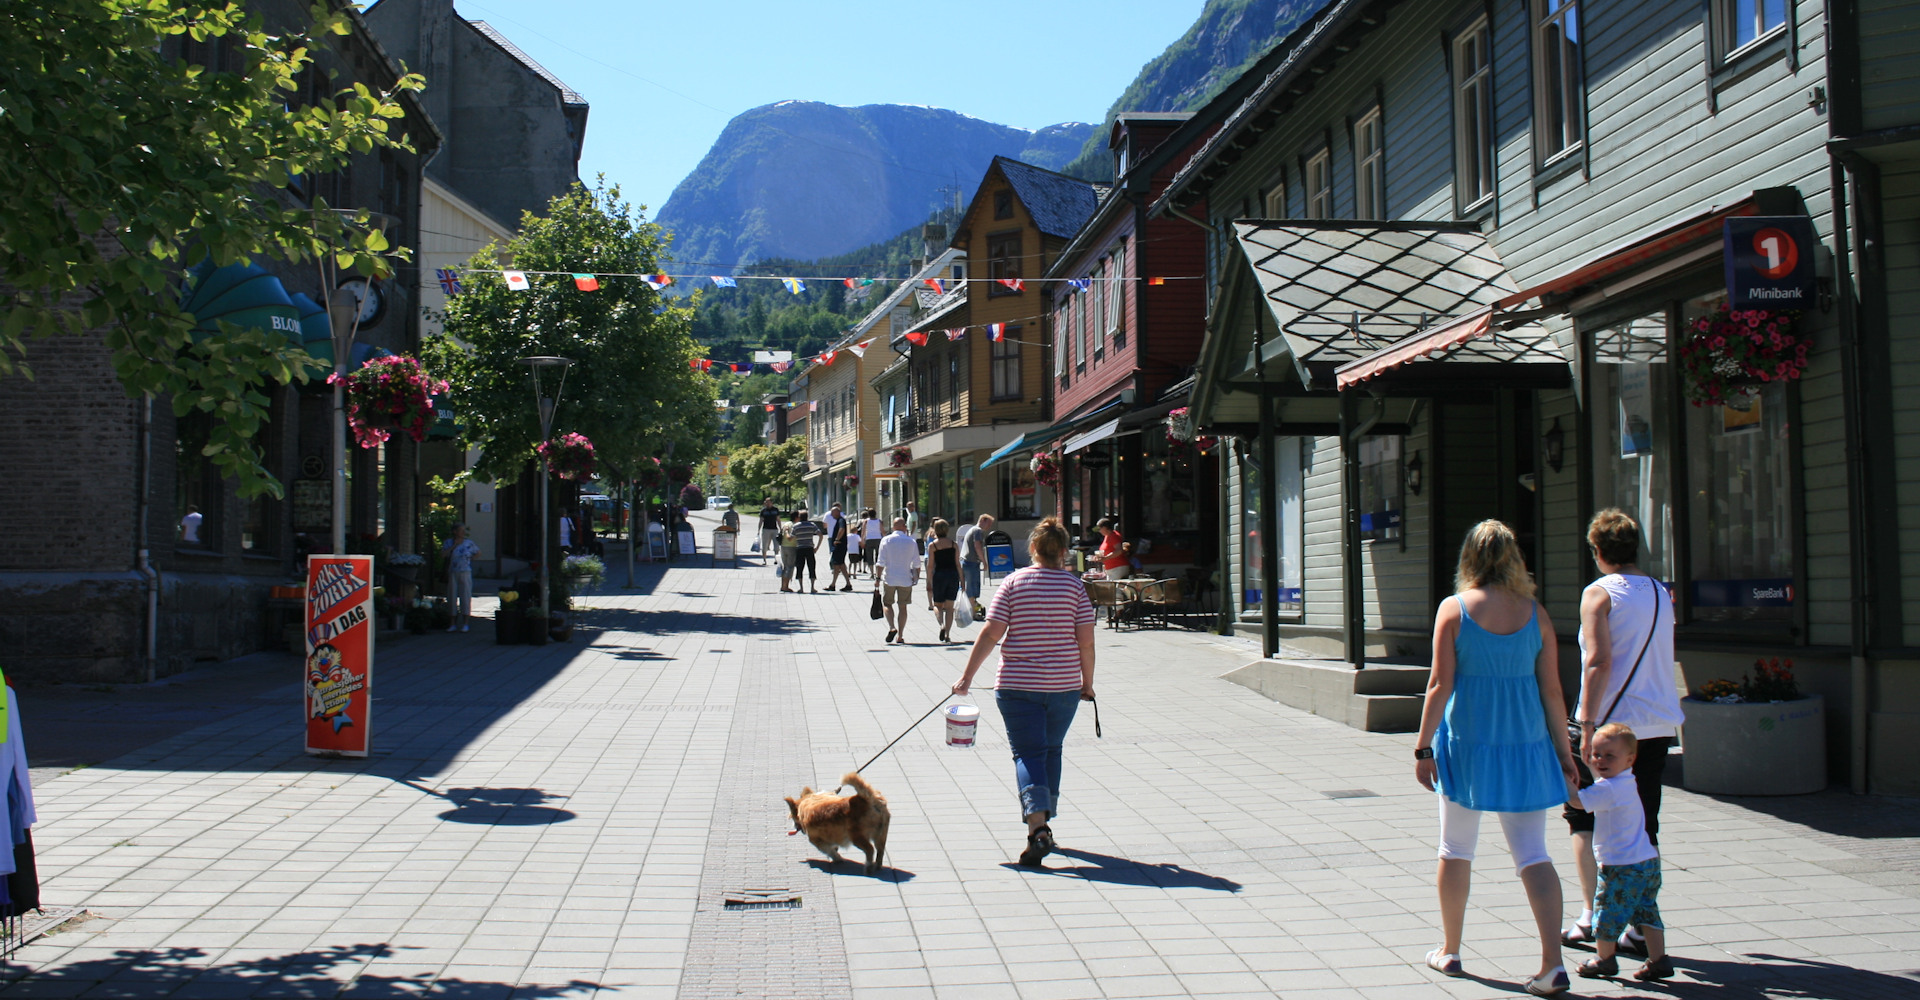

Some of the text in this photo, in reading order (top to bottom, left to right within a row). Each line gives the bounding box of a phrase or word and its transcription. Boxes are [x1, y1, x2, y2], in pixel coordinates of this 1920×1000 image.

[1761, 236, 1780, 270] 1
[1749, 287, 1802, 299] Minibank
[312, 574, 368, 622] ZORBA
[1753, 587, 1784, 599] SpareBank
[332, 605, 367, 635] I DAG
